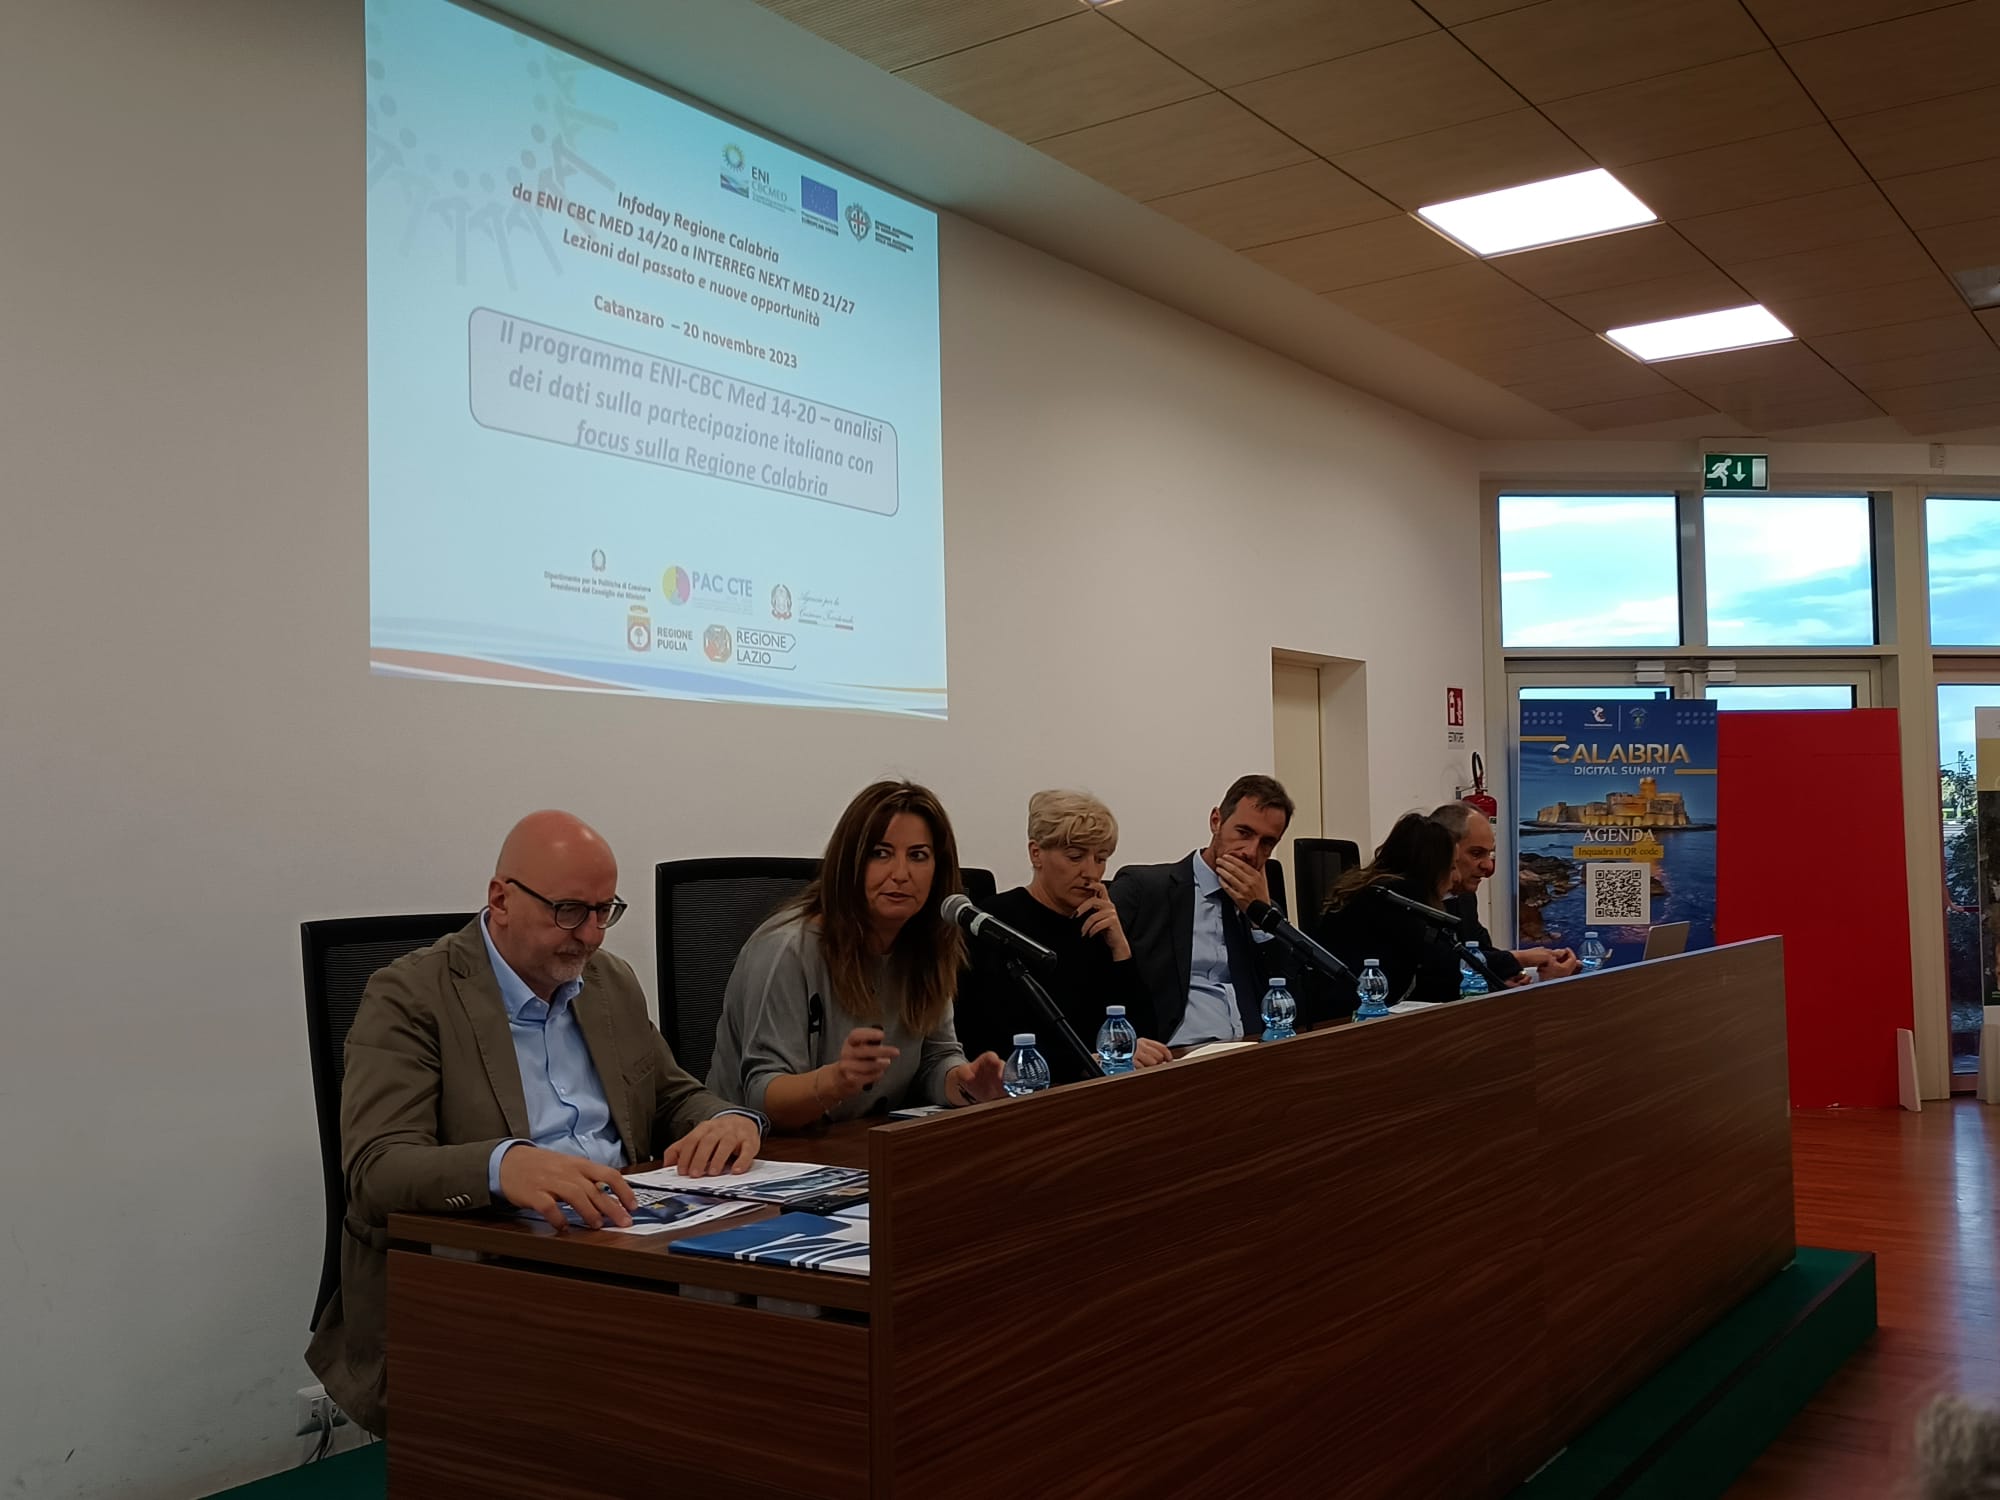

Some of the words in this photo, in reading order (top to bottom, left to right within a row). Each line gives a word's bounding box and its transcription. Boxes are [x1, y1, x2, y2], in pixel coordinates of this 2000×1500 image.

[751, 166, 770, 185] ENI
[617, 192, 671, 227] Infoday
[673, 212, 726, 244] Regione
[729, 234, 779, 263] Calabria
[512, 183, 532, 203] da
[537, 191, 563, 213] ENI
[567, 202, 596, 224] CBC
[599, 212, 634, 237] MED
[637, 226, 678, 253] 14/20
[681, 244, 689, 257] a
[693, 245, 756, 280] INTERREG
[758, 269, 790, 292] NEXT
[792, 281, 820, 302] MED
[822, 292, 855, 315] 21/27
[563, 228, 614, 258] Lezioni
[617, 248, 640, 267] dal
[643, 258, 695, 285] passato
[698, 277, 706, 289] e
[709, 279, 748, 303] nuove
[751, 295, 820, 327] opportunità
[594, 295, 664, 329] Catanzaro
[683, 321, 699, 339] 20
[703, 330, 766, 359] novembre
[769, 348, 798, 369] 2023
[500, 319, 514, 344] Il
[519, 330, 644, 379] programma
[650, 361, 724, 400] ENI-CBC
[728, 383, 767, 412] Med
[771, 395, 816, 425] 14-20
[834, 415, 883, 444] analisi
[509, 364, 543, 393] dei
[549, 374, 590, 405] dati
[595, 391, 642, 417] sulla
[647, 404, 779, 451] partecipazione
[783, 433, 844, 467] italiana
[847, 454, 873, 475] con
[575, 419, 630, 453] focus
[634, 437, 679, 464] sulla
[685, 446, 756, 481] Regione
[761, 463, 828, 497] Calabria
[692, 571, 724, 593] PAC
[727, 577, 753, 598] CTE
[657, 627, 693, 641] REGIONE
[737, 630, 787, 649] REGIONE
[657, 639, 688, 651] PUGLIA
[737, 649, 771, 665] LAZIO
[1552, 743, 1691, 764] CALABRIA
[1574, 766, 1618, 776] DIGITAL
[1621, 766, 1667, 776] SUMMIT
[1582, 828, 1656, 842] AGENDA
[1578, 848, 1614, 857] Inquadra
[1623, 847, 1637, 857] QR
[1639, 848, 1659, 856] code
